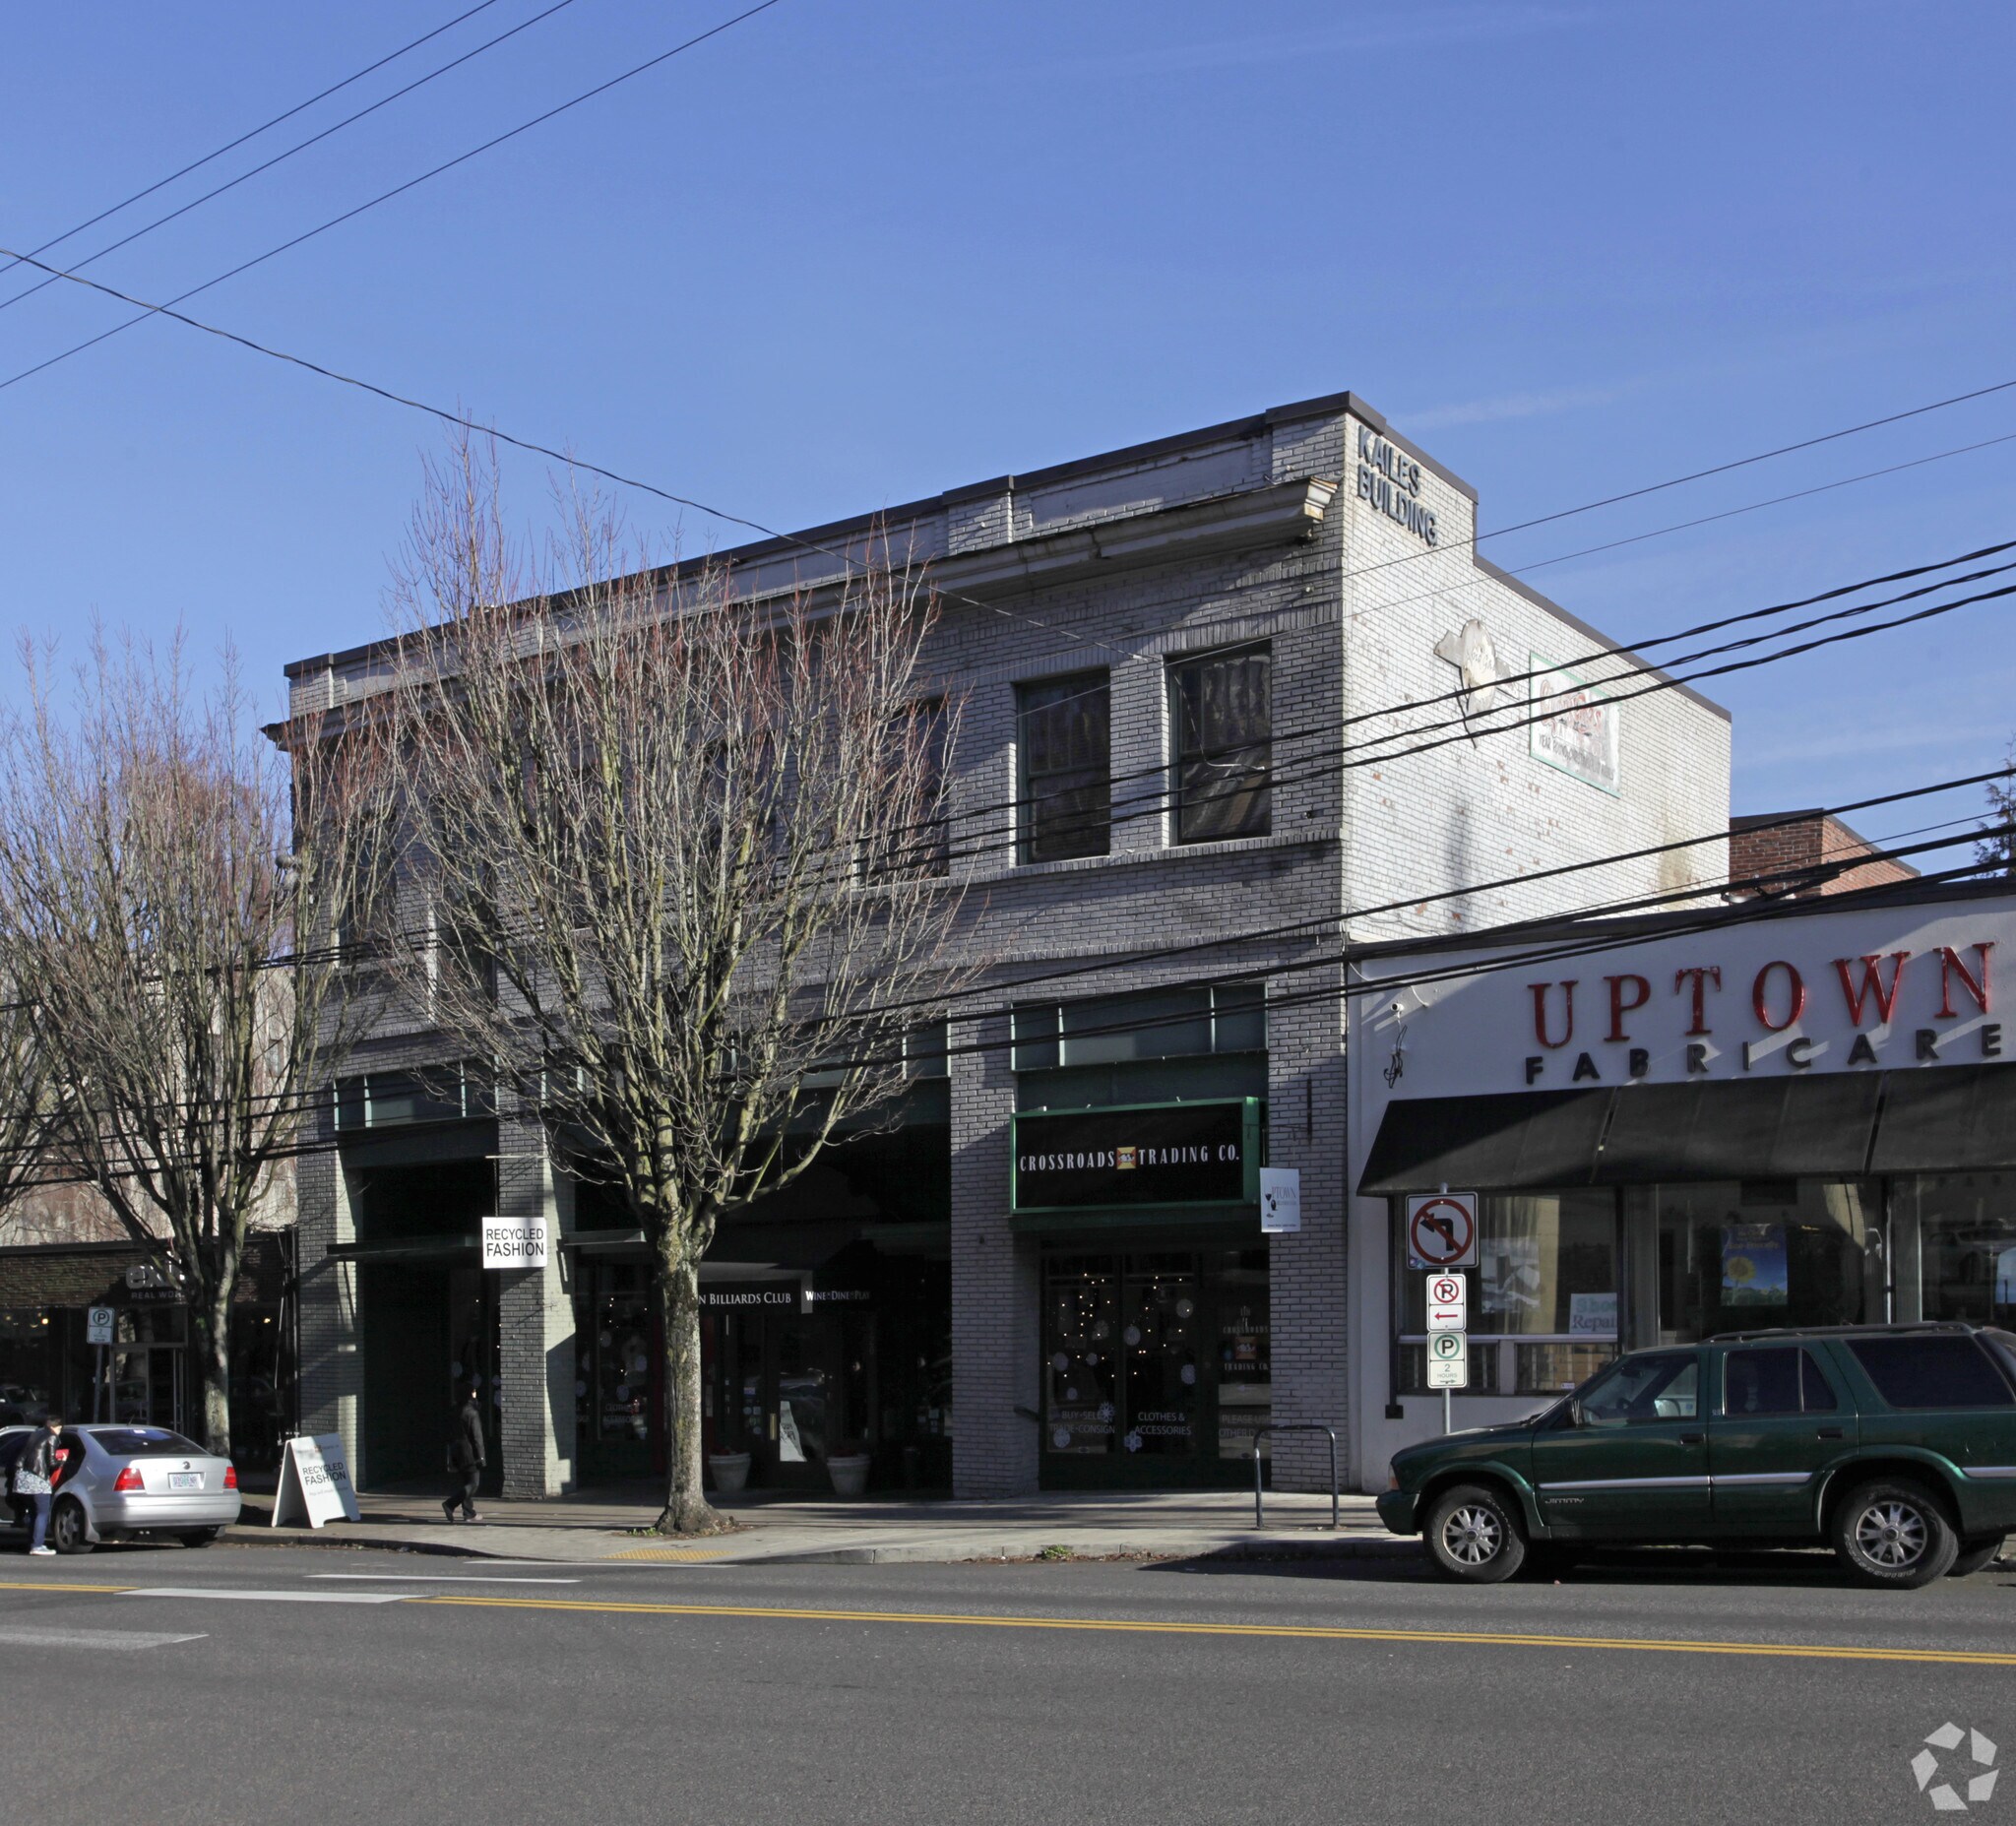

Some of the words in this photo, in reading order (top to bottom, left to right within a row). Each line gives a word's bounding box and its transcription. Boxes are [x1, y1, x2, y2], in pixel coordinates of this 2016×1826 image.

[1357, 424, 1420, 498] KAILES
[1357, 464, 1437, 547] BUILDING
[1527, 941, 1995, 1048] UPTOWN
[1526, 1024, 2001, 1085] FABRICARE
[1020, 1151, 1114, 1171] CROSSROADS
[1139, 1145, 1209, 1165] TRADING
[1218, 1144, 1240, 1162] CO.
[486, 1228, 543, 1240] RECYCLED
[486, 1242, 544, 1257] FASHION
[131, 1291, 157, 1299] REAL
[710, 1292, 761, 1305] BILLIARDS
[764, 1291, 791, 1304] CLUB
[805, 1291, 827, 1301] WINE
[831, 1291, 850, 1300] DINE
[97, 1312, 106, 1323] P
[1572, 1315, 1616, 1332] Repai
[1441, 1339, 1455, 1354] P
[1444, 1363, 1451, 1372] 2
[1138, 1412, 1176, 1421] CLOTHES
[1222, 1414, 1253, 1424] PLEASE
[1134, 1425, 1192, 1435] ACCESSORIES
[302, 1462, 344, 1476] RECYCLED
[304, 1470, 346, 1486] FASHION
